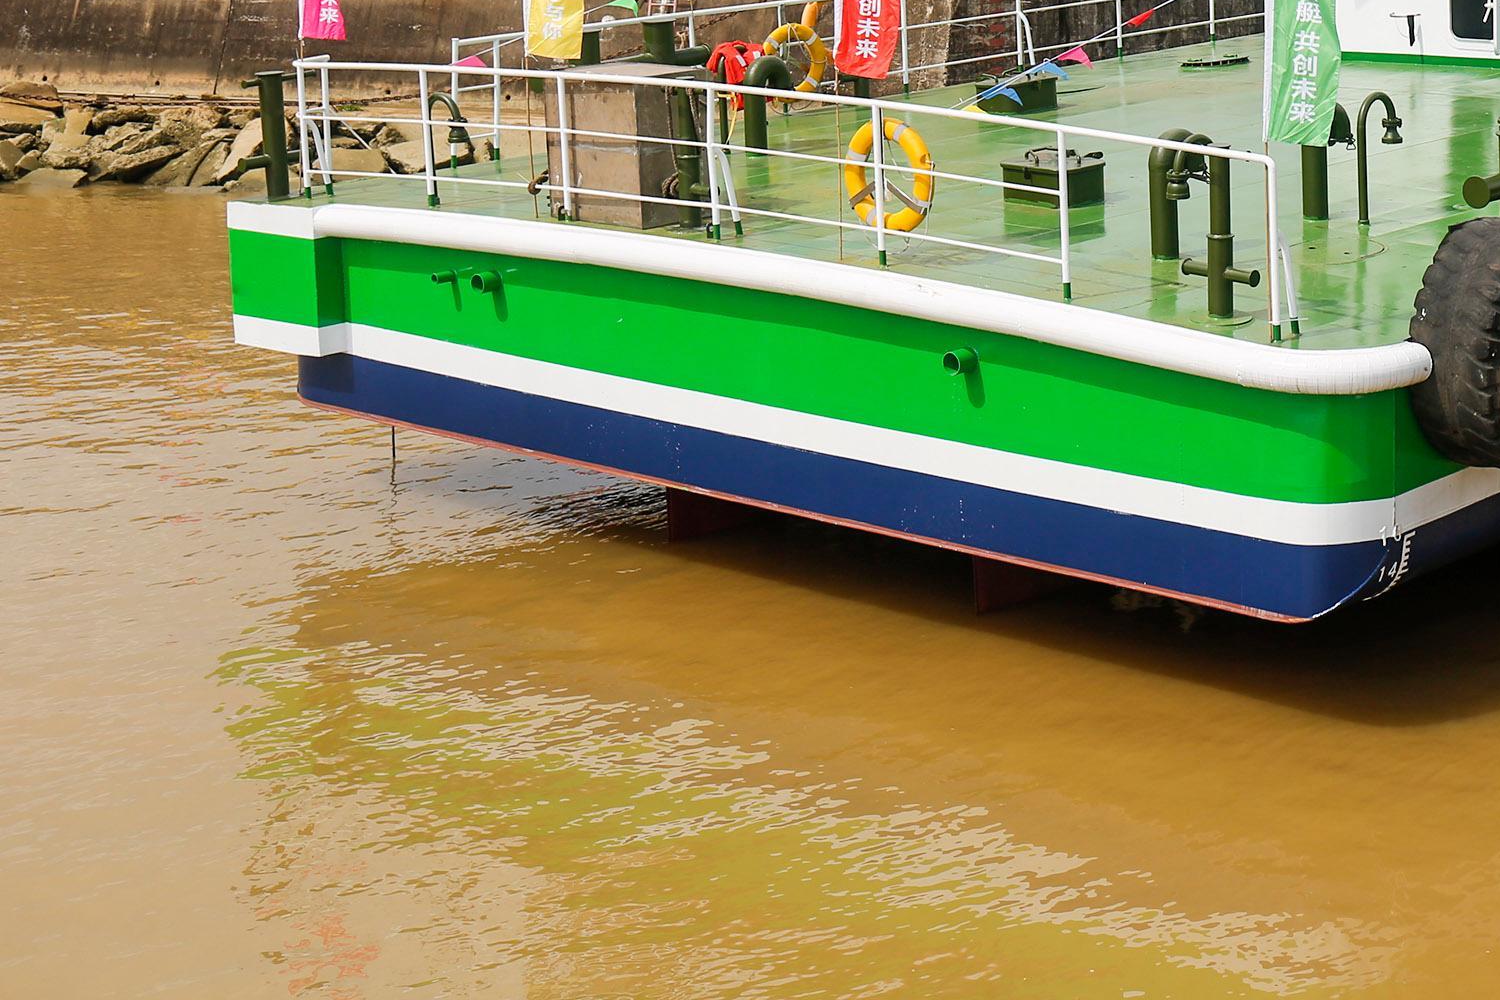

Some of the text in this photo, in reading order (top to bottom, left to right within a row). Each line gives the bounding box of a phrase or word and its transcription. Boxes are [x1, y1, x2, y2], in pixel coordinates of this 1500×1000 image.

[1289, 30, 1321, 124] 共创未来
[1378, 561, 1398, 582] 14
